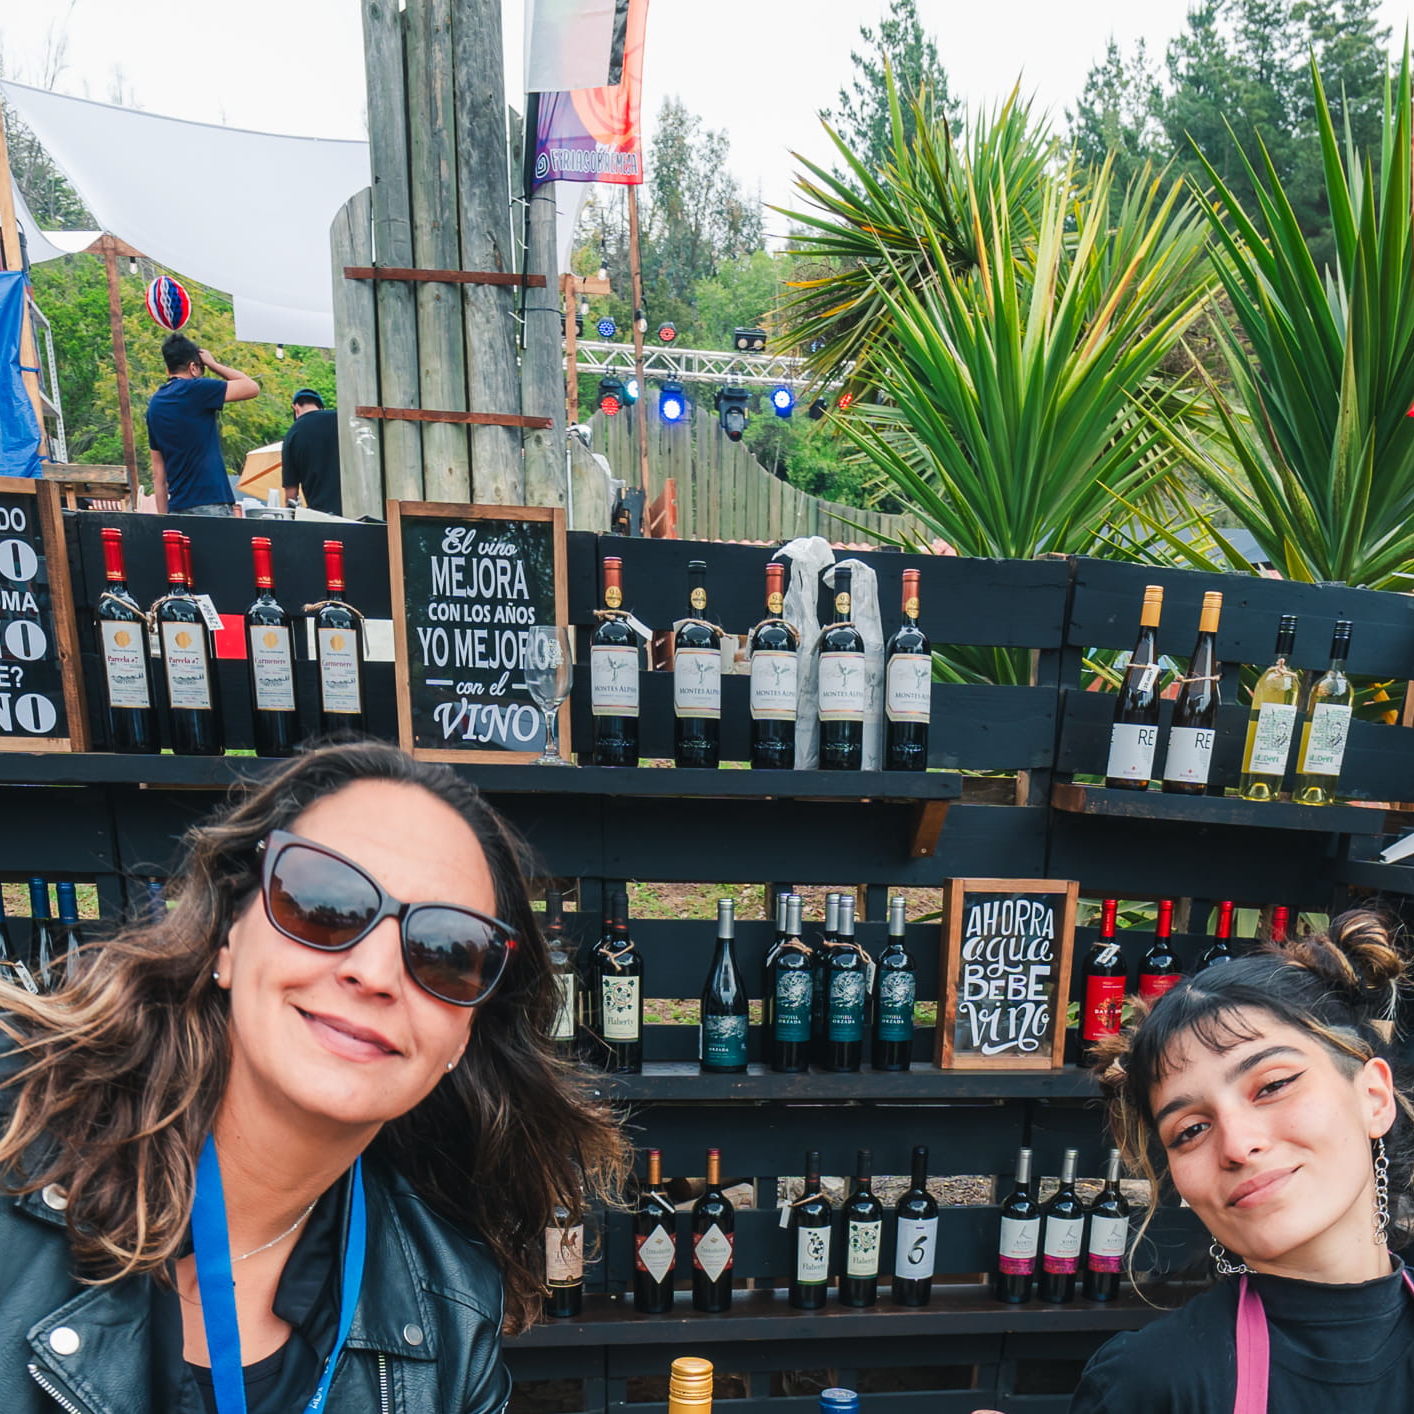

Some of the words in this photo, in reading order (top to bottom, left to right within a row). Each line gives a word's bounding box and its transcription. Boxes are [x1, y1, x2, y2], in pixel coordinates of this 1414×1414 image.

[442, 527, 476, 554] El
[479, 537, 518, 557] vino
[430, 555, 530, 600] MEJORA
[428, 602, 461, 621] CON
[463, 604, 491, 623] LOS
[494, 602, 536, 624] AÑOS
[417, 626, 449, 667] YO
[454, 628, 548, 671] MEJORO
[456, 680, 485, 695] con
[489, 671, 510, 697] el
[594, 685, 618, 693] MONTES
[679, 687, 705, 695] MONTES
[755, 689, 781, 697] MONTES
[823, 690, 848, 698] MONTES
[433, 697, 540, 743] VINO
[1139, 728, 1155, 746] RE
[1195, 732, 1212, 750] RE
[966, 900, 1054, 939] AHORRA
[962, 937, 1053, 977] agua
[964, 964, 1051, 1001] BEBE
[907, 1235, 928, 1265] 6
